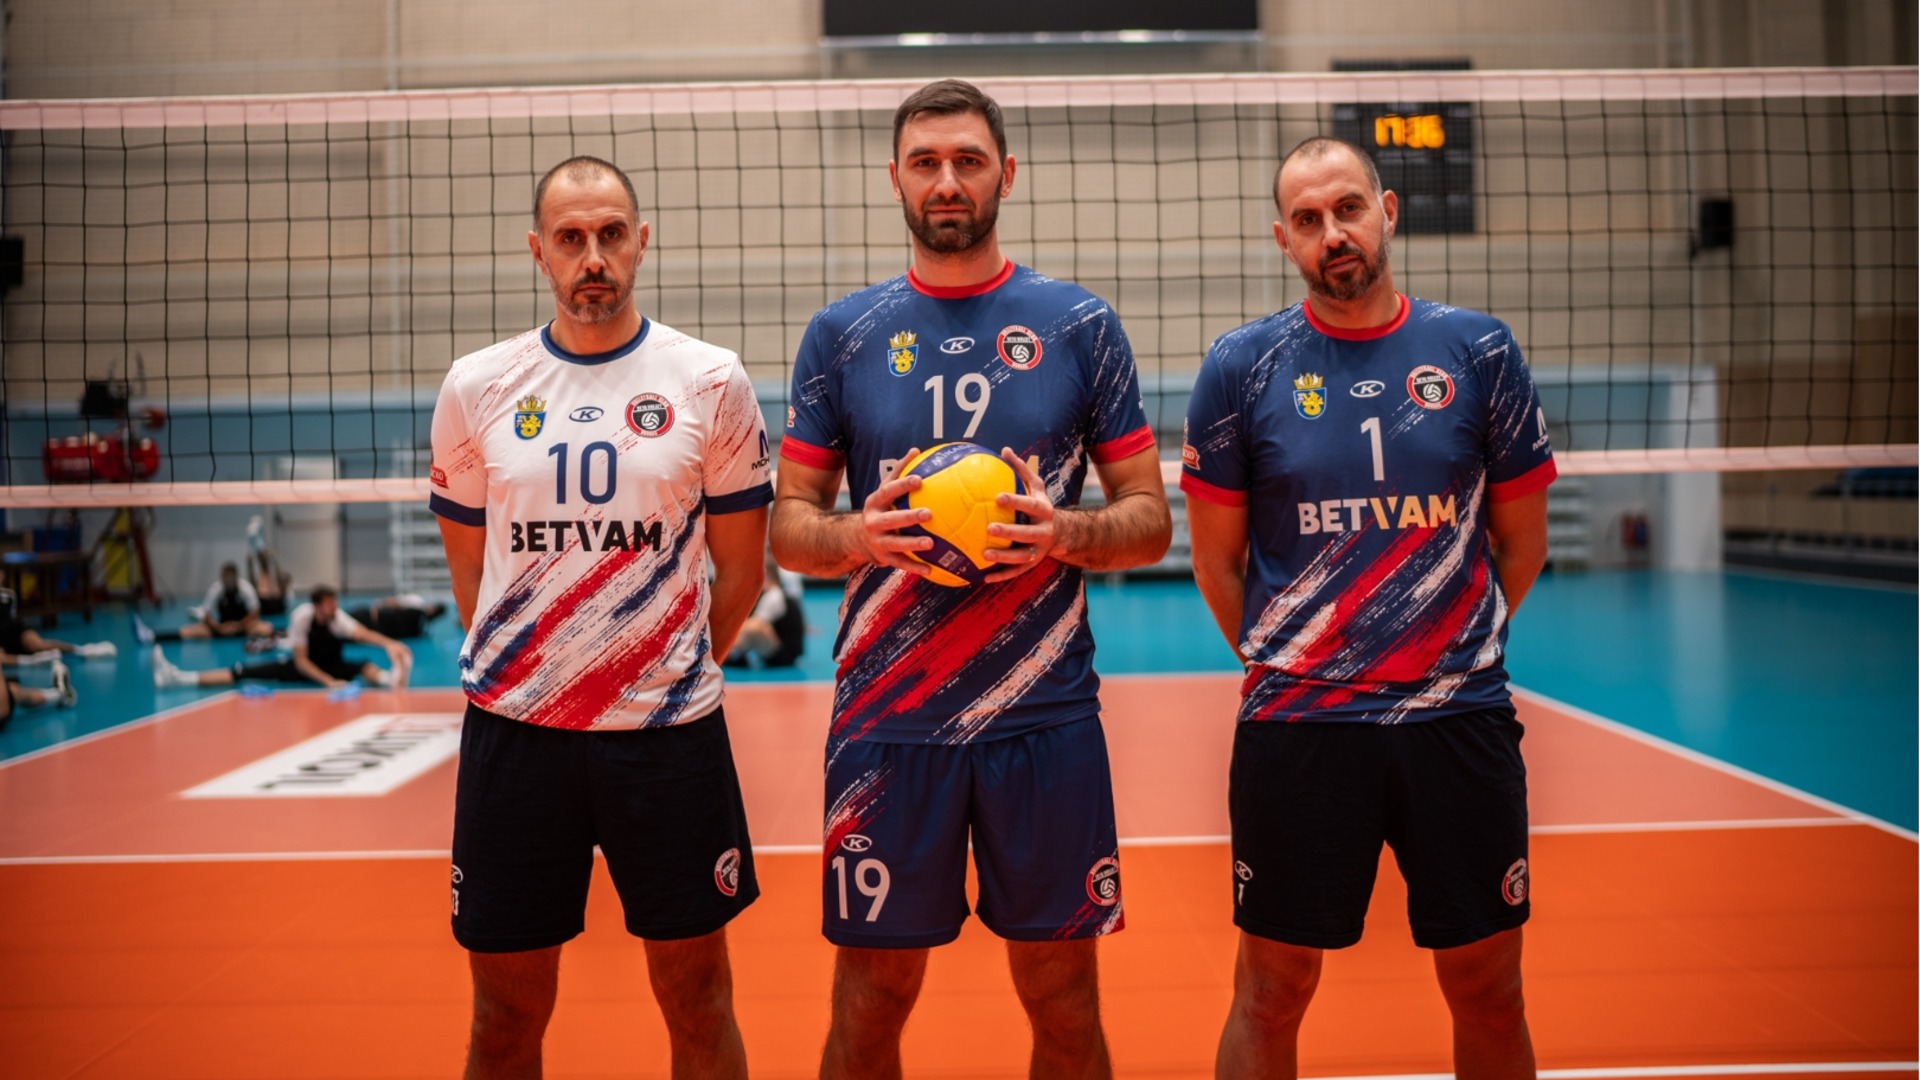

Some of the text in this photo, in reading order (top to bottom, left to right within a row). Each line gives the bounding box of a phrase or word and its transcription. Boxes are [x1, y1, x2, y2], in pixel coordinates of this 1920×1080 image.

[924, 372, 991, 439] 19
[547, 441, 618, 505] 10
[1360, 416, 1385, 482] 1
[831, 855, 891, 922] 19
